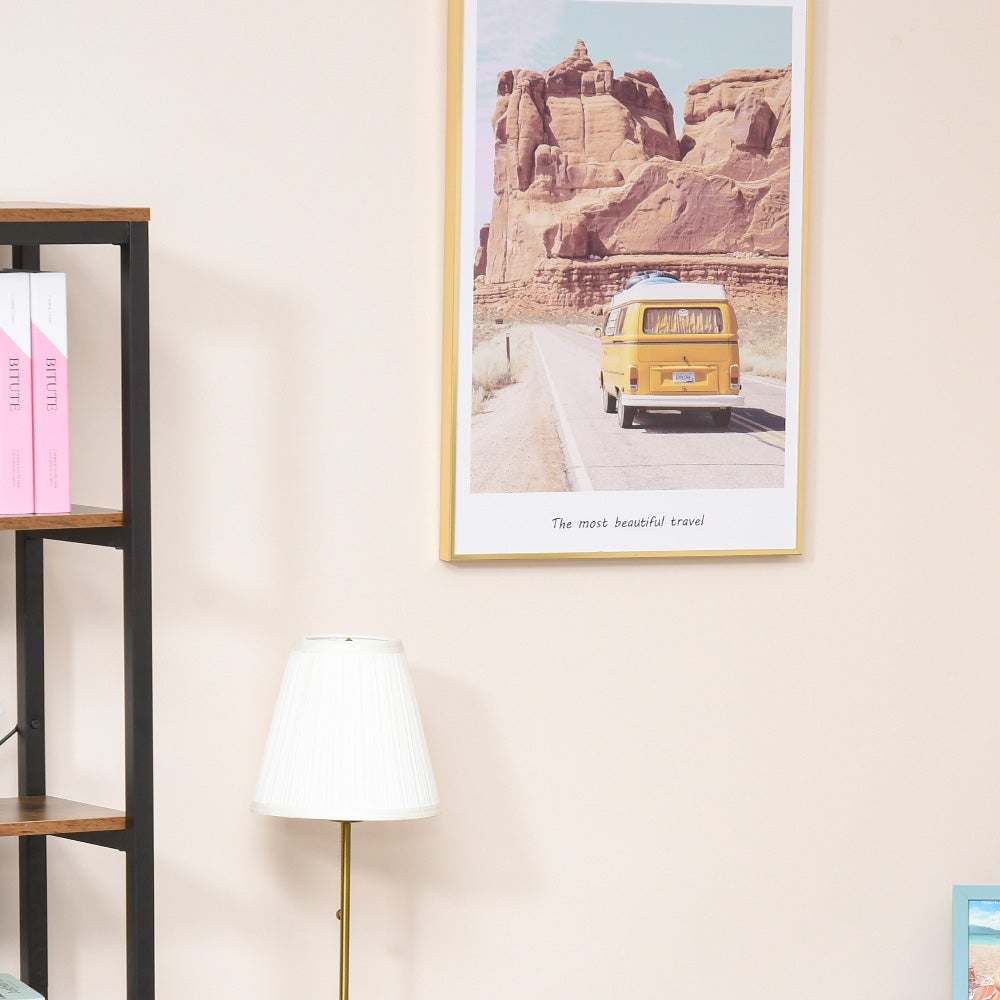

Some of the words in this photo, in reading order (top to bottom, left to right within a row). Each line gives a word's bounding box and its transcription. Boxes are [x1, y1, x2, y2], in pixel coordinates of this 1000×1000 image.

[9, 358, 20, 411] BITUTE
[46, 358, 57, 411] BITUTE
[551, 517, 572, 529] The
[579, 518, 608, 528] most
[614, 515, 665, 528] beautiful
[670, 514, 705, 527] travel
